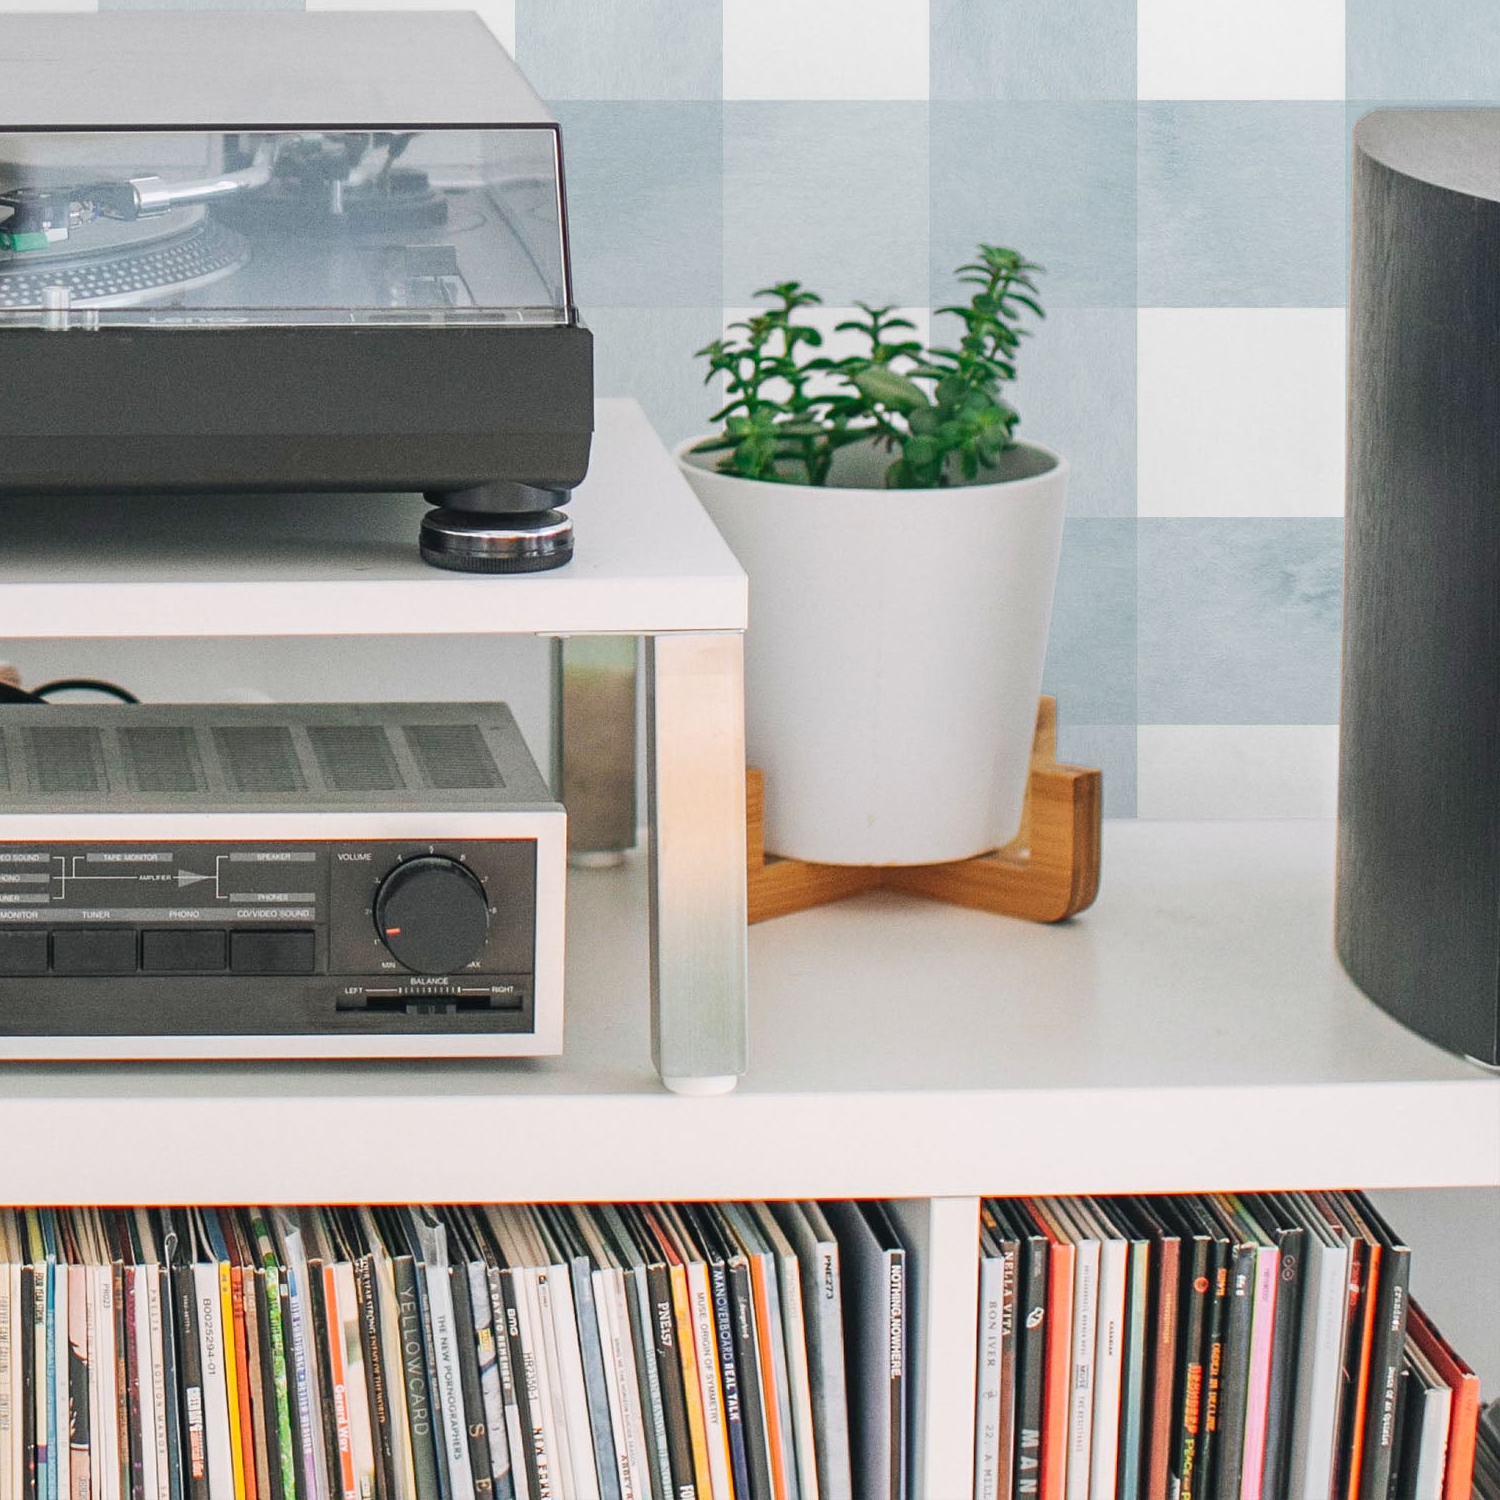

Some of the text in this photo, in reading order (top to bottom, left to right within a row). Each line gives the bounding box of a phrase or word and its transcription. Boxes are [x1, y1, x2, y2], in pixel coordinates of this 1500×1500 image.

[337, 853, 372, 861] VOLUME
[0, 911, 38, 919] MONITOR
[82, 911, 110, 919] TUNER
[169, 910, 200, 918] PHONO
[237, 910, 277, 918] CD/VIDEO
[344, 986, 363, 994] LEFT
[36, 1272, 44, 1325] FOUR YEAR STRONG
[823, 1255, 834, 1299] PNE273
[1002, 1251, 1014, 1336] NELLA VITA
[202, 1298, 216, 1375] B0025294-01
[492, 1292, 511, 1390] DAY TO REMEMBER
[507, 1308, 518, 1337] BMG
[657, 1301, 672, 1347] PNE157
[0, 1296, 9, 1431] FOREVER CAME CALLING CONTENDER
[364, 1282, 386, 1424] YEAR STRONG ENEMY OF THE WORLD
[399, 1286, 430, 1436] YELLOWCARD
[699, 1324, 718, 1425] ORIGIN OF SYMMETRY
[984, 1301, 998, 1462] BON IVER A
[1078, 1365, 1087, 1389] MUSE
[1381, 1286, 1403, 1446] grandson Death Of An Optimist
[153, 1363, 162, 1407] BOSTON
[437, 1315, 462, 1460] THE NEW PORNOGRAPHERS
[523, 1352, 544, 1456] HR2350-1 NEW
[723, 1362, 740, 1421] REAL TALK
[1205, 1343, 1221, 1432] ORDER IN DECLINE
[156, 1414, 165, 1454] MANOR
[335, 1384, 350, 1453] Gerard Way
